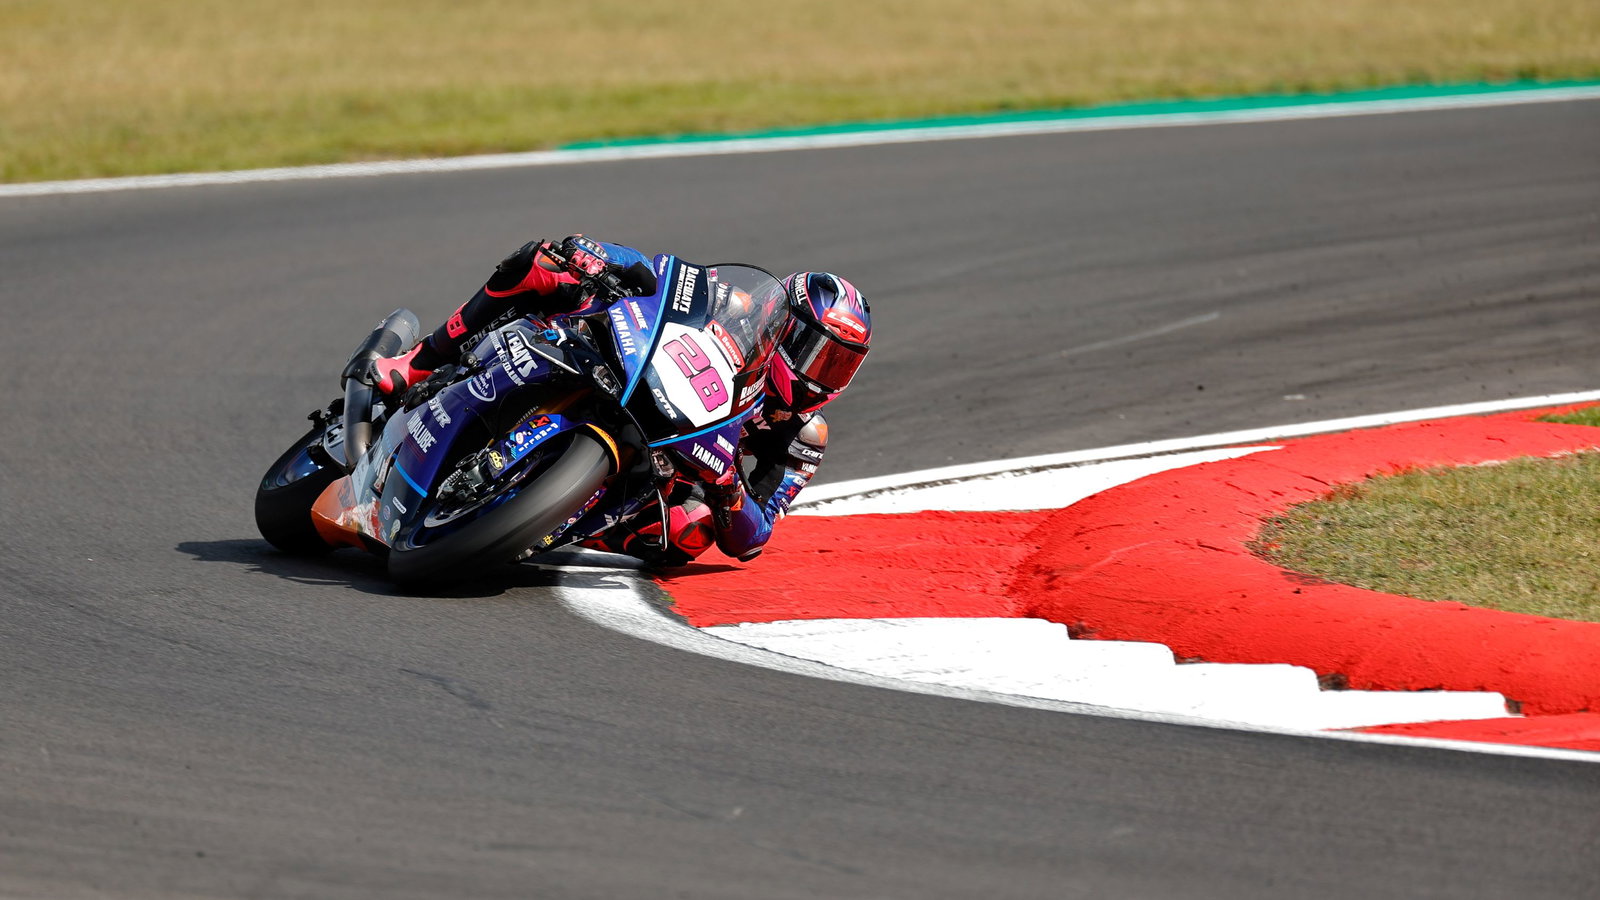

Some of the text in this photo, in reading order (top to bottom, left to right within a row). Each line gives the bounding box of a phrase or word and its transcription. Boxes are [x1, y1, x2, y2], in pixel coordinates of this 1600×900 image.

[680, 266, 700, 314] RACEWAYS
[460, 306, 517, 353] DAINESE
[610, 307, 638, 356] YAMAHA
[827, 312, 866, 334] LS2
[722, 336, 741, 366] Bennett
[662, 333, 729, 412] 28
[427, 396, 451, 428] GYTR
[652, 387, 677, 420] GYTR
[518, 422, 559, 452] PIRELLI
[802, 448, 824, 459] DAIN
[691, 442, 725, 475] YAMAHA
